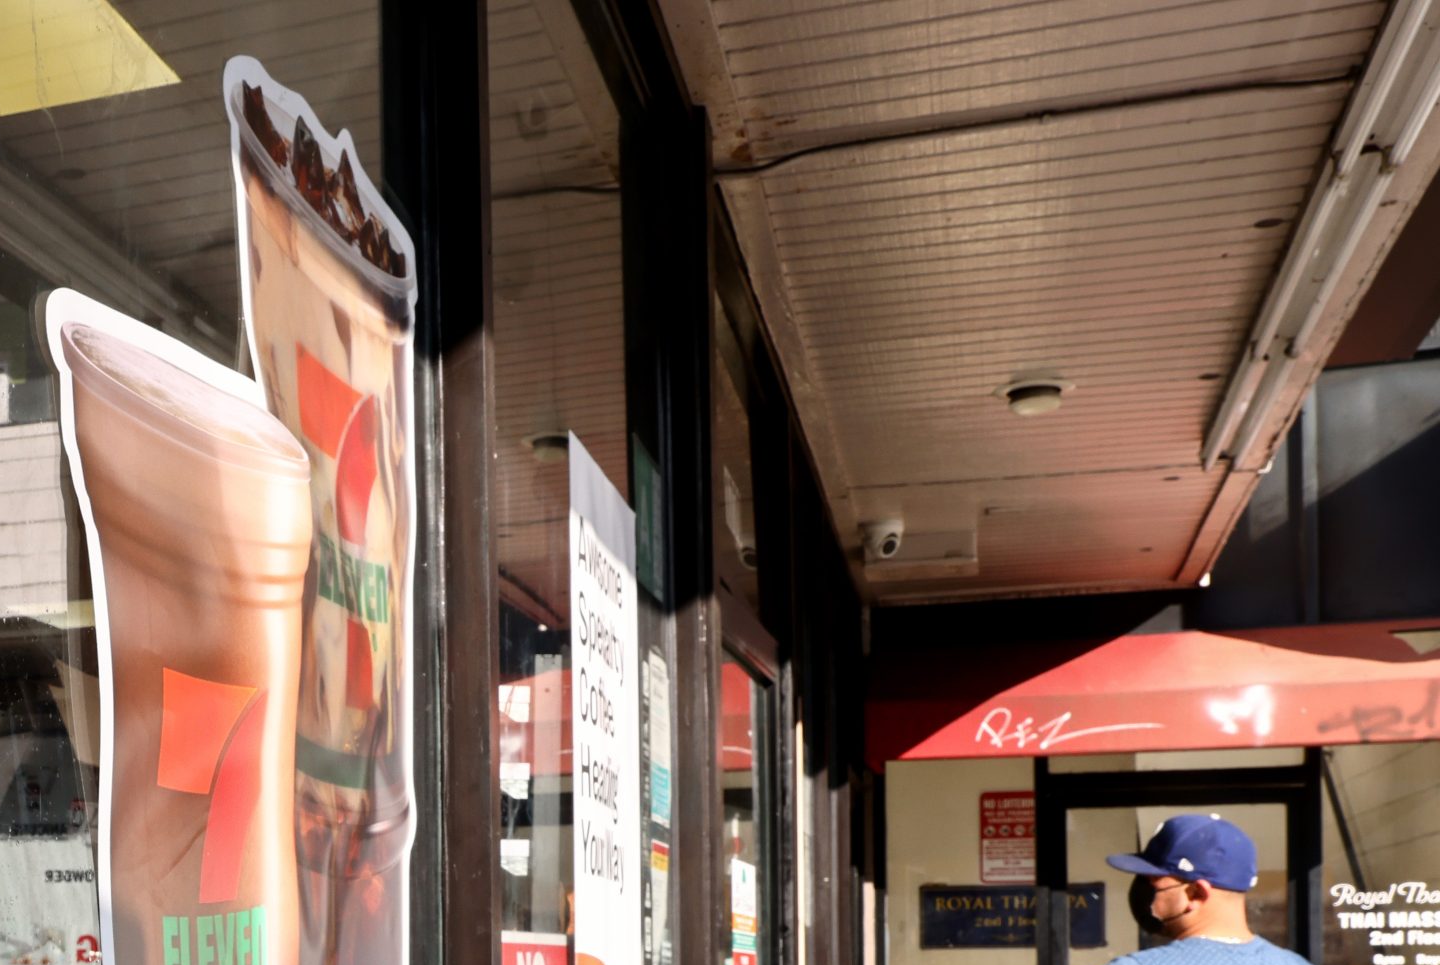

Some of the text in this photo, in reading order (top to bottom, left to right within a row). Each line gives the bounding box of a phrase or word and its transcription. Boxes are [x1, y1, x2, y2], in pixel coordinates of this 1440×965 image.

[578, 515, 622, 609] Awesome
[580, 667, 614, 738] Coffee
[935, 894, 1088, 912] ROYAL THA PA
[1330, 881, 1440, 910] Royal Tha
[1337, 911, 1440, 929] THAI MASS
[1369, 930, 1440, 946] 2nd Floo
